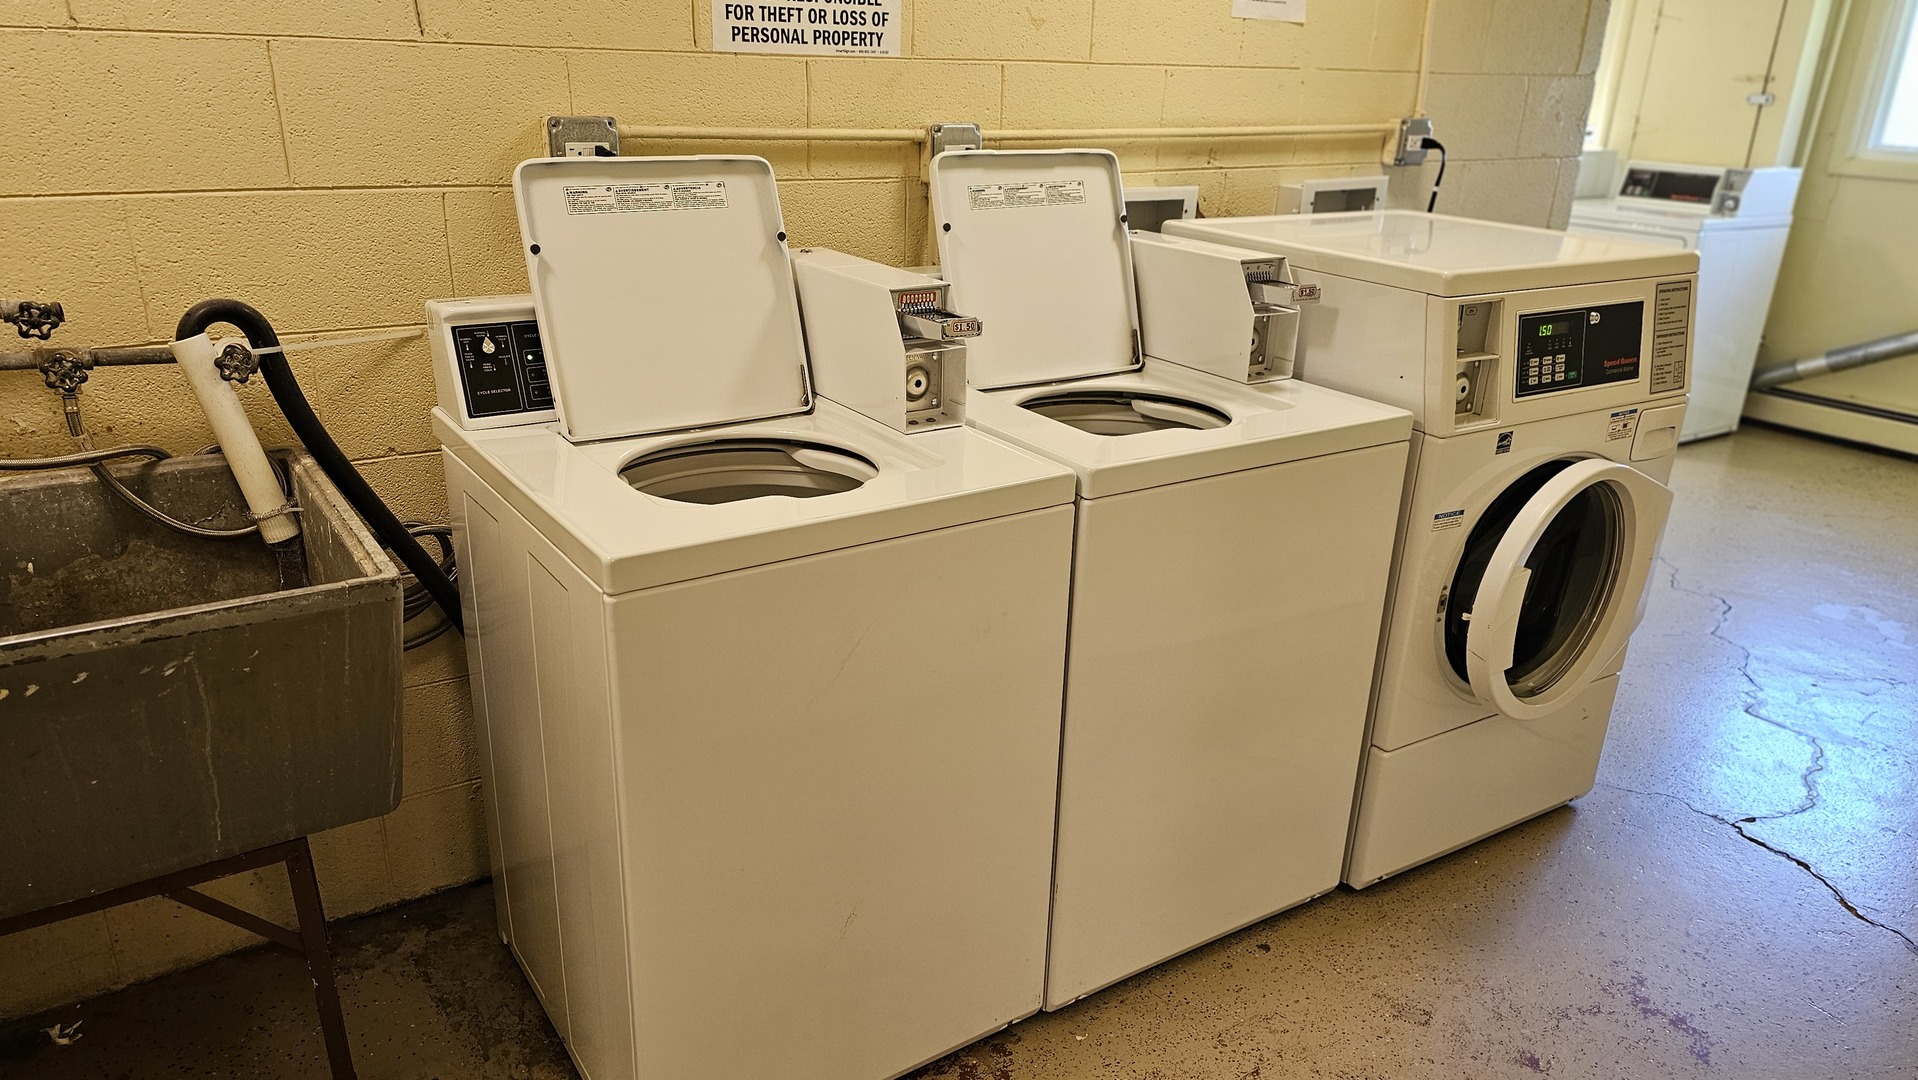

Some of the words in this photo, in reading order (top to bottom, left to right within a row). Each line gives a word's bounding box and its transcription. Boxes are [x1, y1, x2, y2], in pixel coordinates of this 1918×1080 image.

[725, 4, 754, 21] FOR
[759, 5, 803, 23] THEFT
[808, 8, 828, 25] OR
[833, 9, 867, 26] LOSS
[871, 11, 890, 27] OF
[731, 26, 809, 45] PERSONAL
[813, 29, 884, 47] PROPERTY
[954, 322, 975, 331] $1.50
[1603, 359, 1620, 368] Speed
